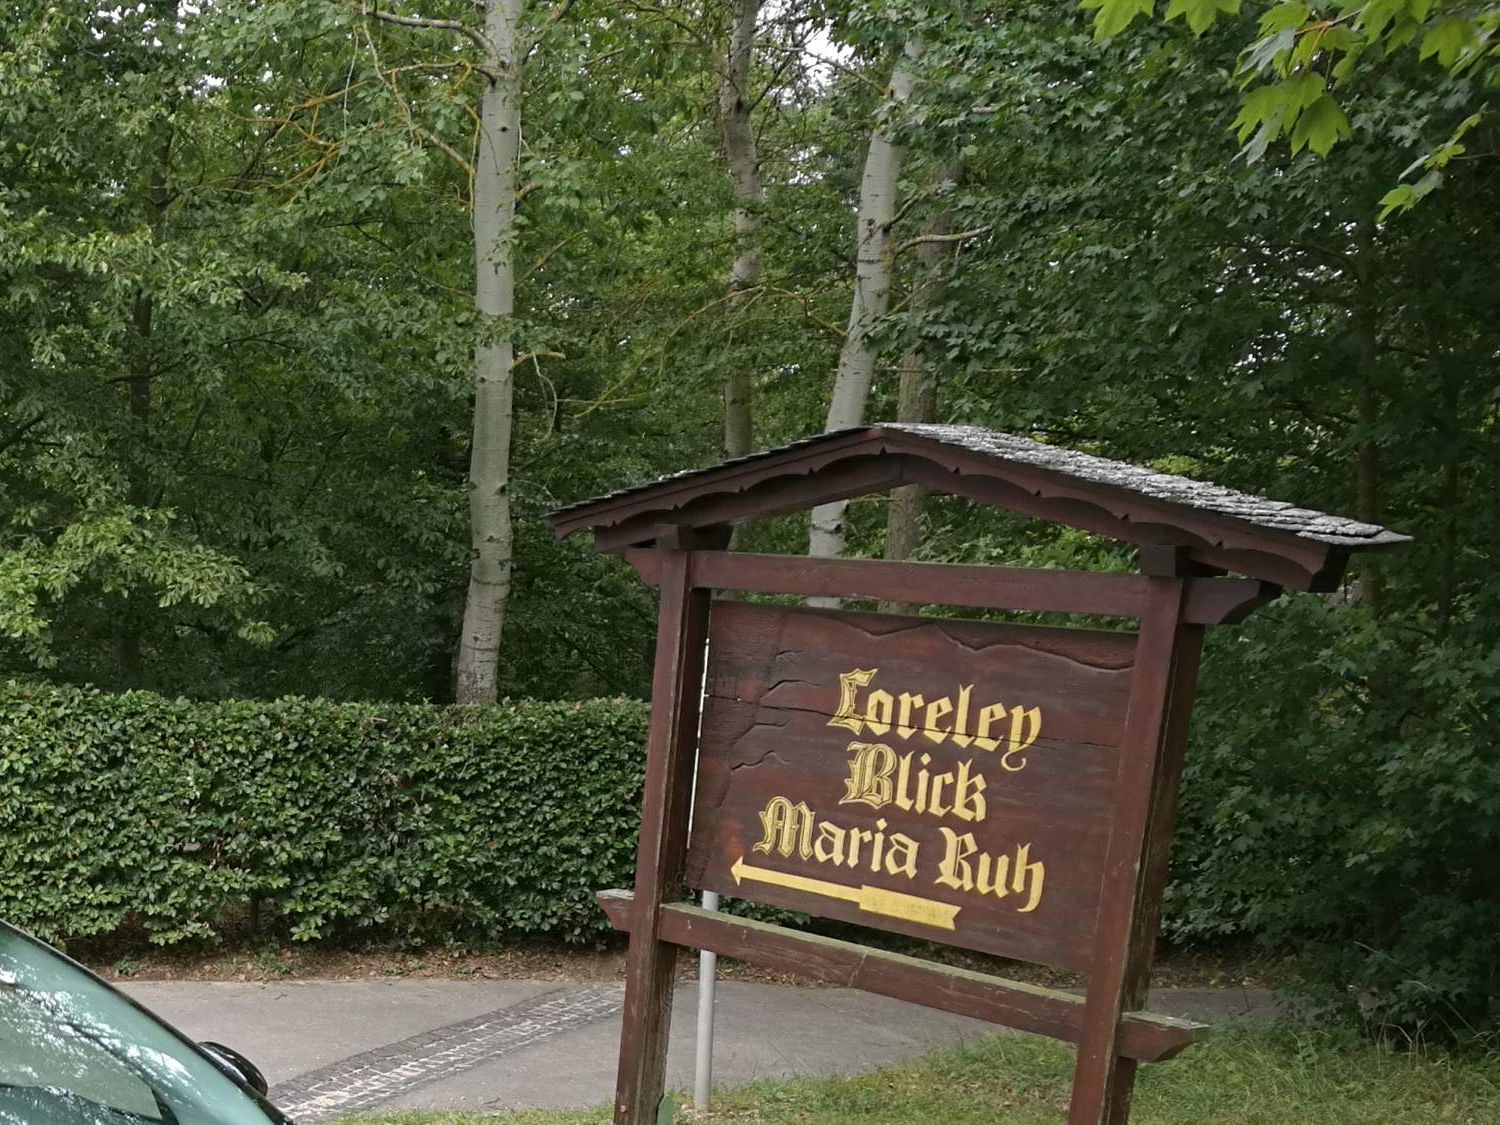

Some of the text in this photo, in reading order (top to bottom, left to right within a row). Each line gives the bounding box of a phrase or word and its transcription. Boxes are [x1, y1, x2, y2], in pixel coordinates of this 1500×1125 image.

[826, 668, 1043, 771] Loreley
[838, 741, 988, 822] Blick
[752, 796, 1046, 913] Maria Ruh
